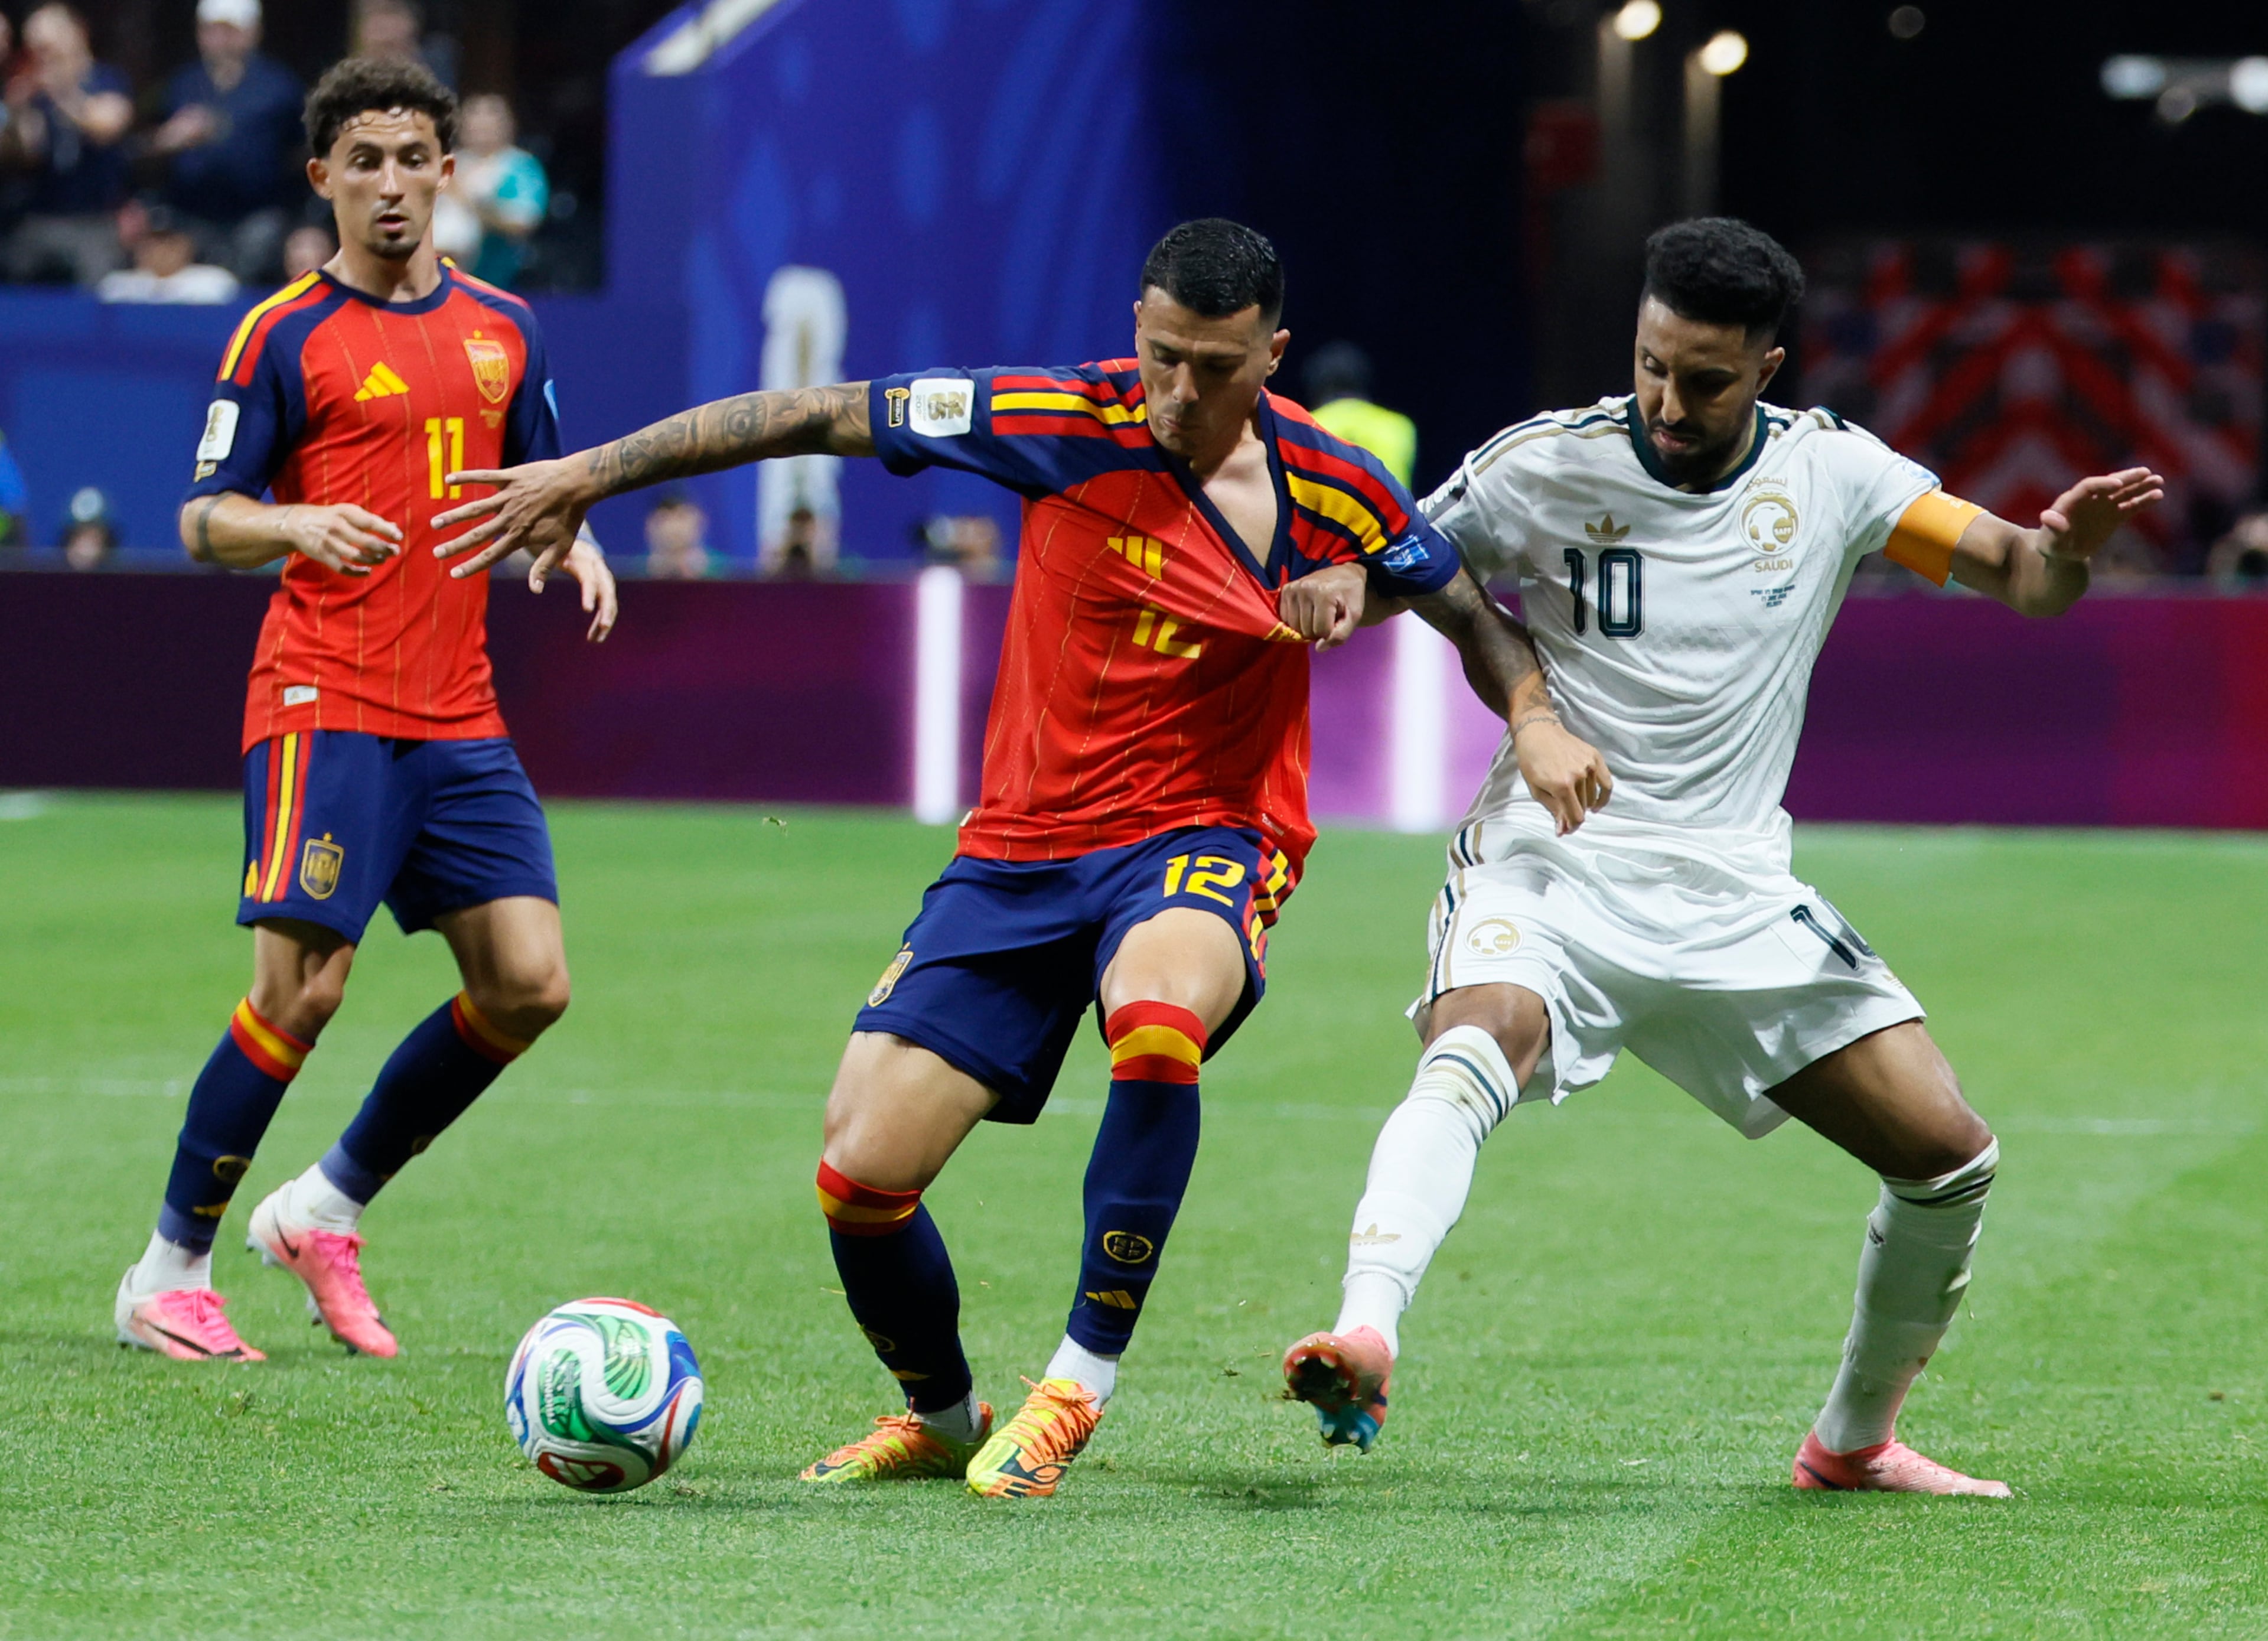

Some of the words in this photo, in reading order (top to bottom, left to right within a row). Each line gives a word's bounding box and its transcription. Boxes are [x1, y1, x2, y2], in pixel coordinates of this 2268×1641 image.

[424, 417, 464, 500] 11
[1564, 548, 1645, 640] 10
[1754, 558, 1794, 573] SAUDI
[1164, 854, 1246, 907] 12
